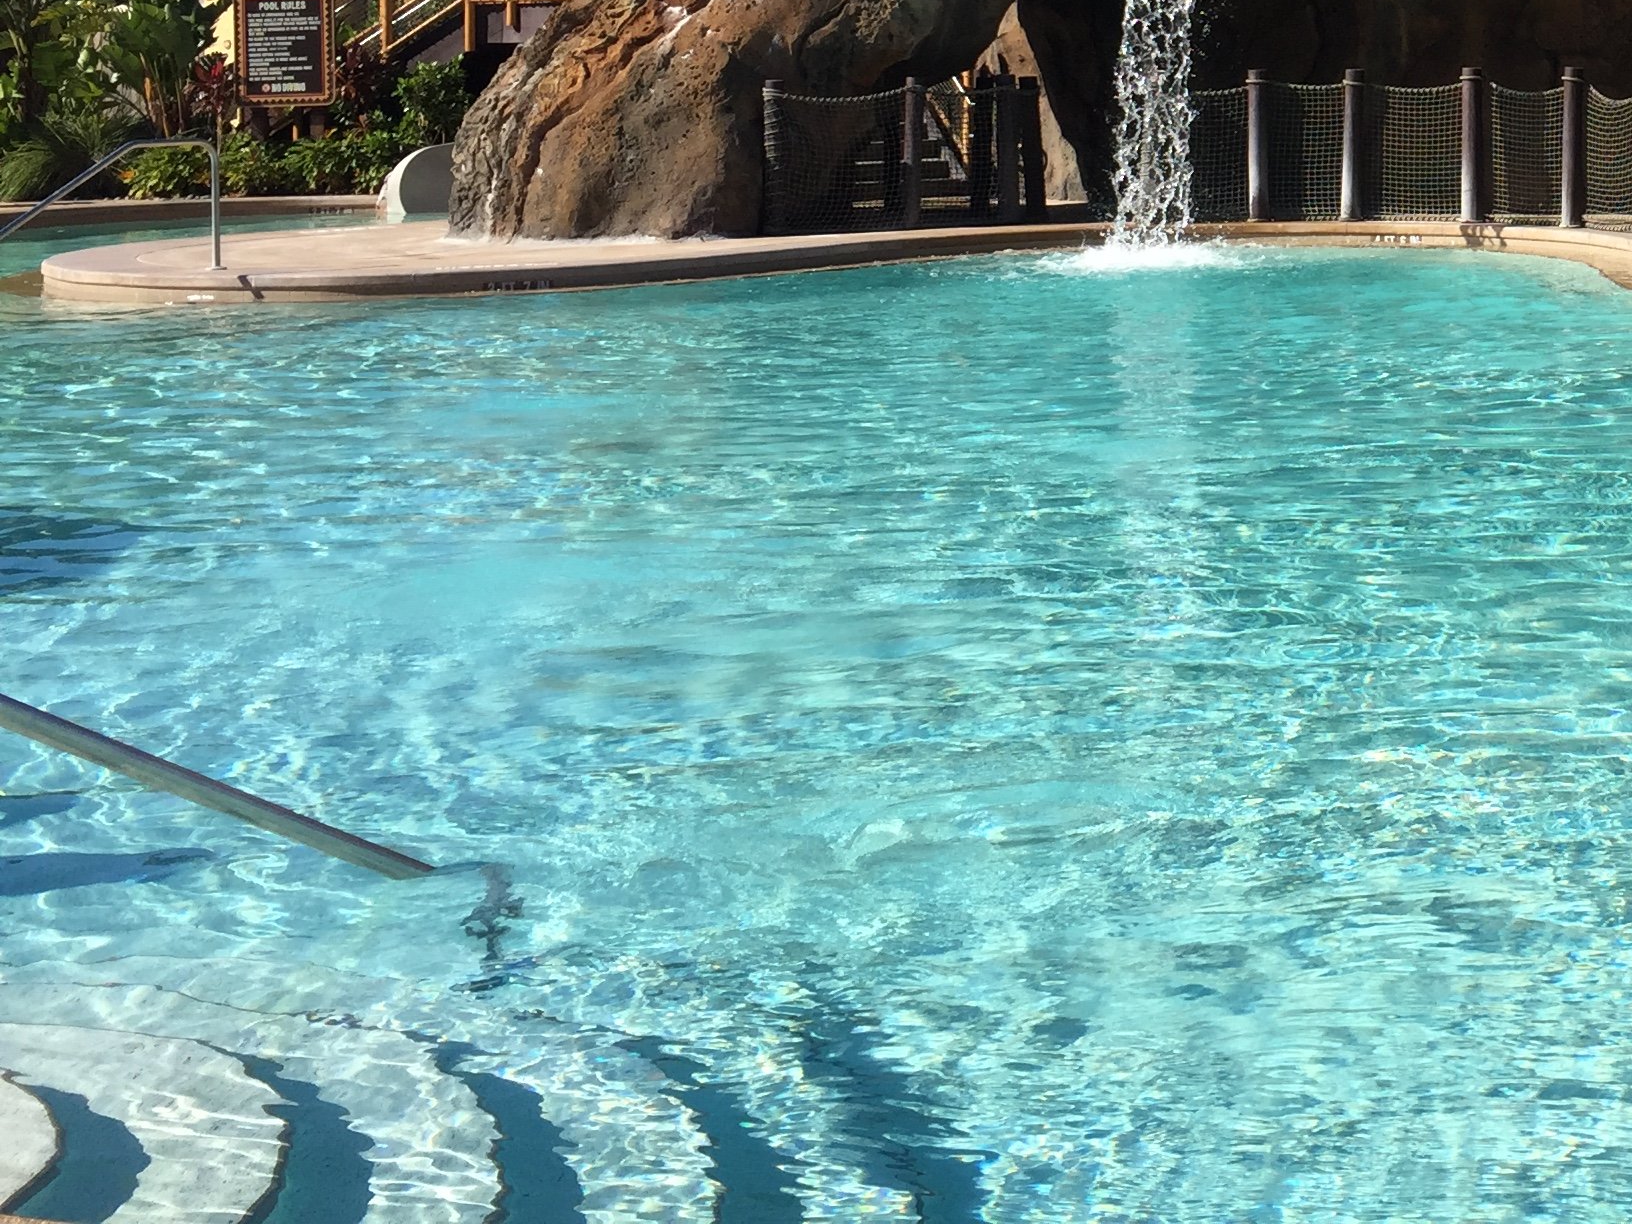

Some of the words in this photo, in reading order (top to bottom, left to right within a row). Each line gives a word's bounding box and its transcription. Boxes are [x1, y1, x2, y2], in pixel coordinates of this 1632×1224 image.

[258, 1, 279, 11] POOL
[281, 0, 306, 11] RULES
[271, 83, 281, 93] NO
